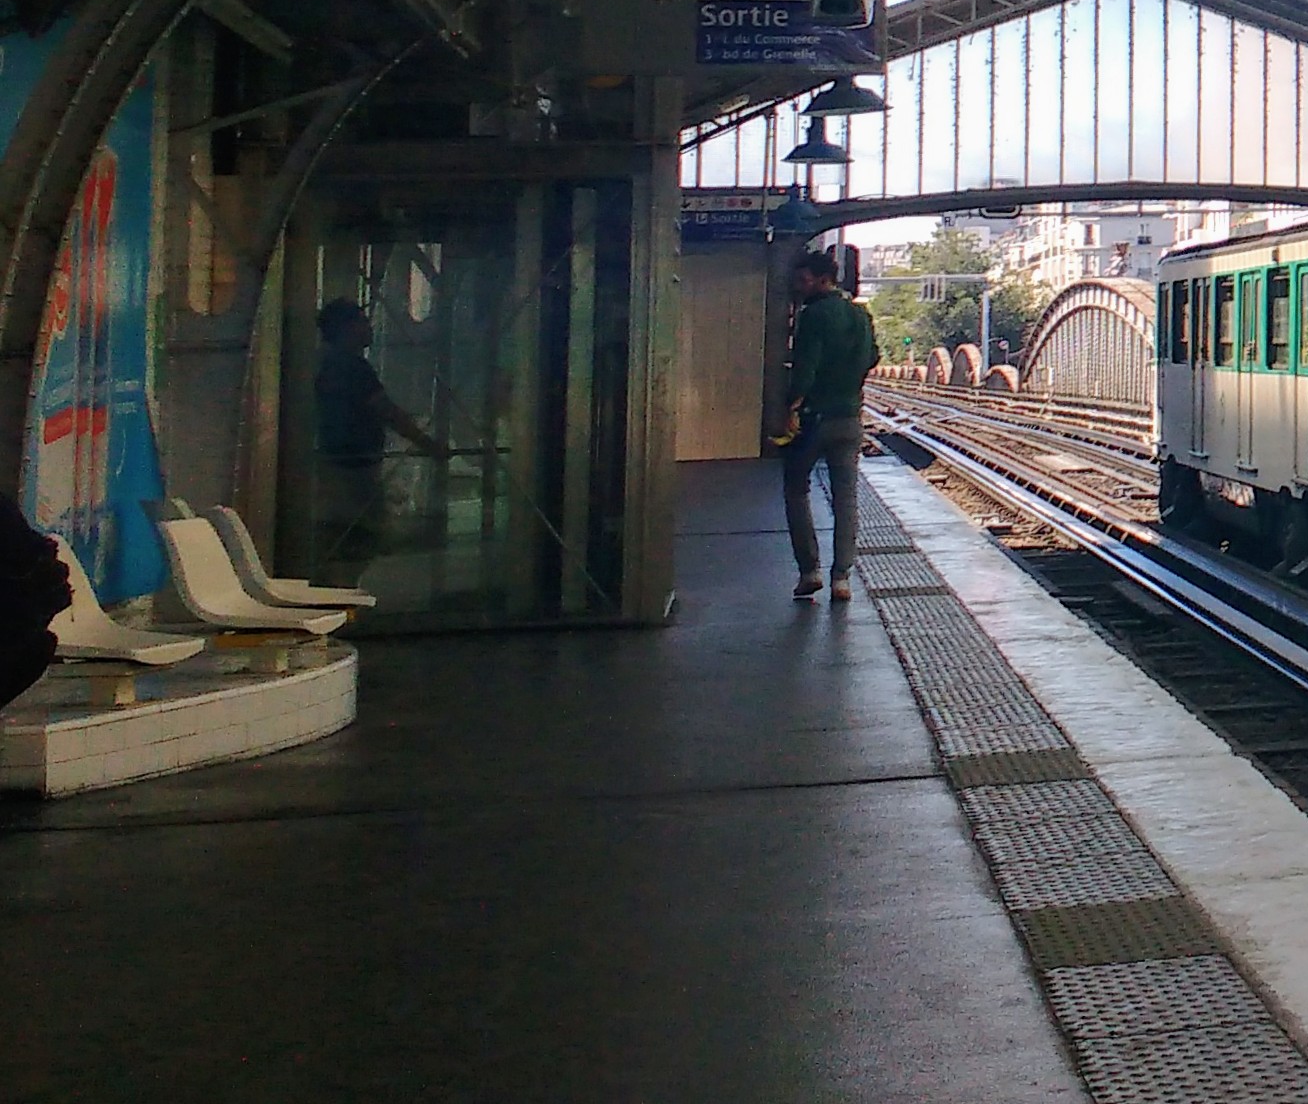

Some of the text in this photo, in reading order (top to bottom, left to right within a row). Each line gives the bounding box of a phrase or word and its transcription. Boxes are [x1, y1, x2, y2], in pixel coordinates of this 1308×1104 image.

[700, 3, 789, 27] Sortie
[754, 34, 821, 45] Commerce
[763, 48, 817, 60] Grenelle
